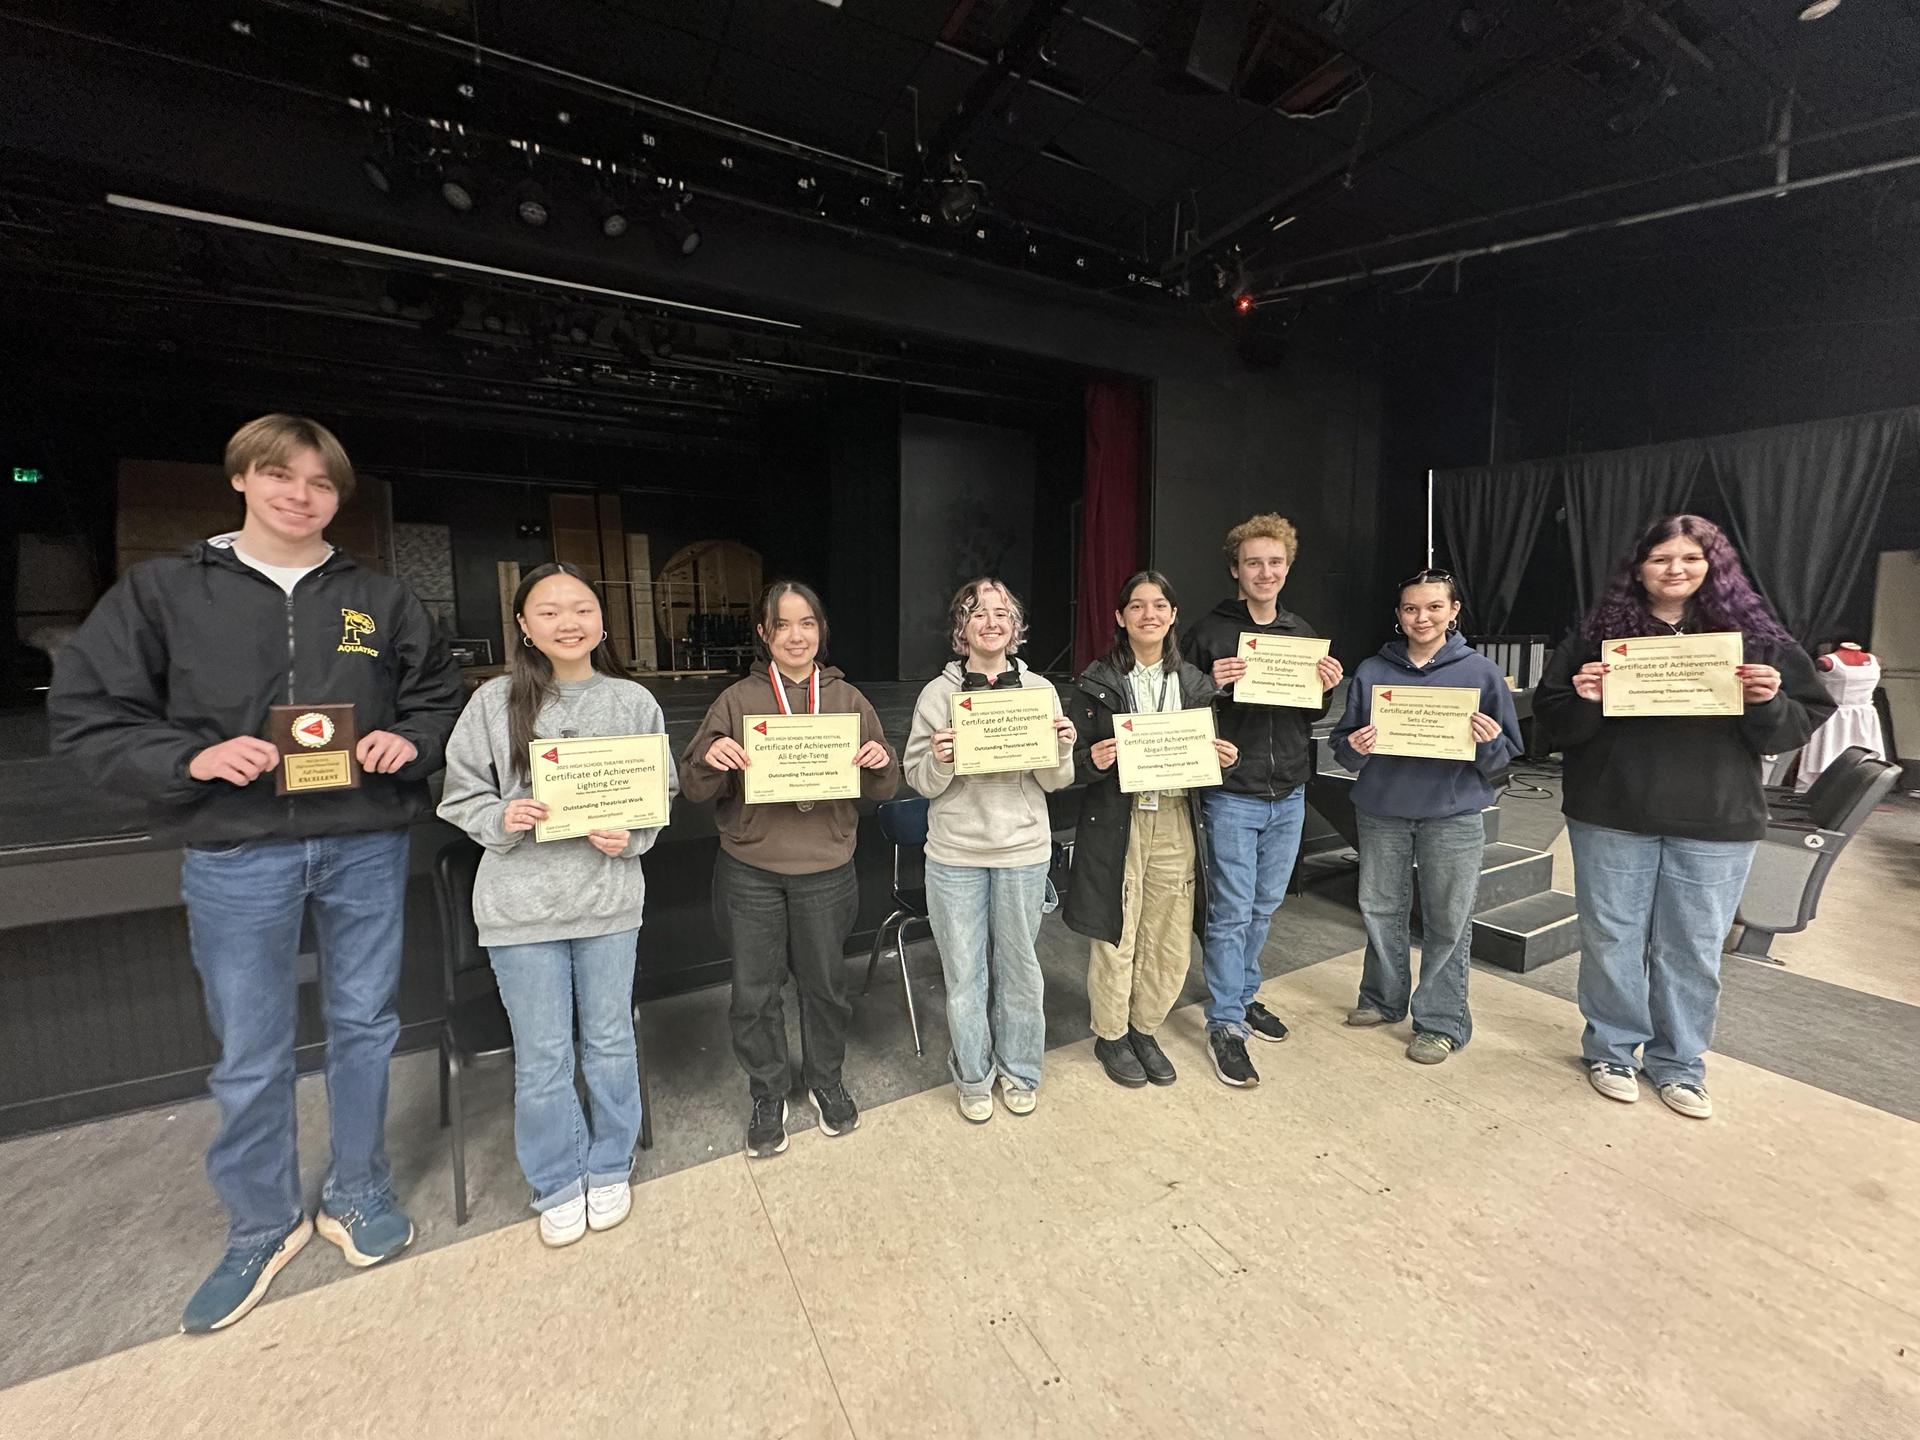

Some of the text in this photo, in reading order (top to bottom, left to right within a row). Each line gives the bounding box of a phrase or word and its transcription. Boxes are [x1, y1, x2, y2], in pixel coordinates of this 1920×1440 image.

[643, 134, 656, 146] 50
[337, 644, 379, 657] AQUATICS
[1670, 660, 1729, 668] Achievement
[962, 718, 996, 726] Certificate
[1006, 714, 1048, 722] Achievement
[1165, 734, 1206, 743] Achievement
[755, 743, 793, 751] Certificate
[545, 764, 656, 782] Certificate of Achievement
[299, 774, 338, 783] EXCELLENT
[577, 780, 608, 790] Lighting
[562, 802, 599, 812] Outstanding
